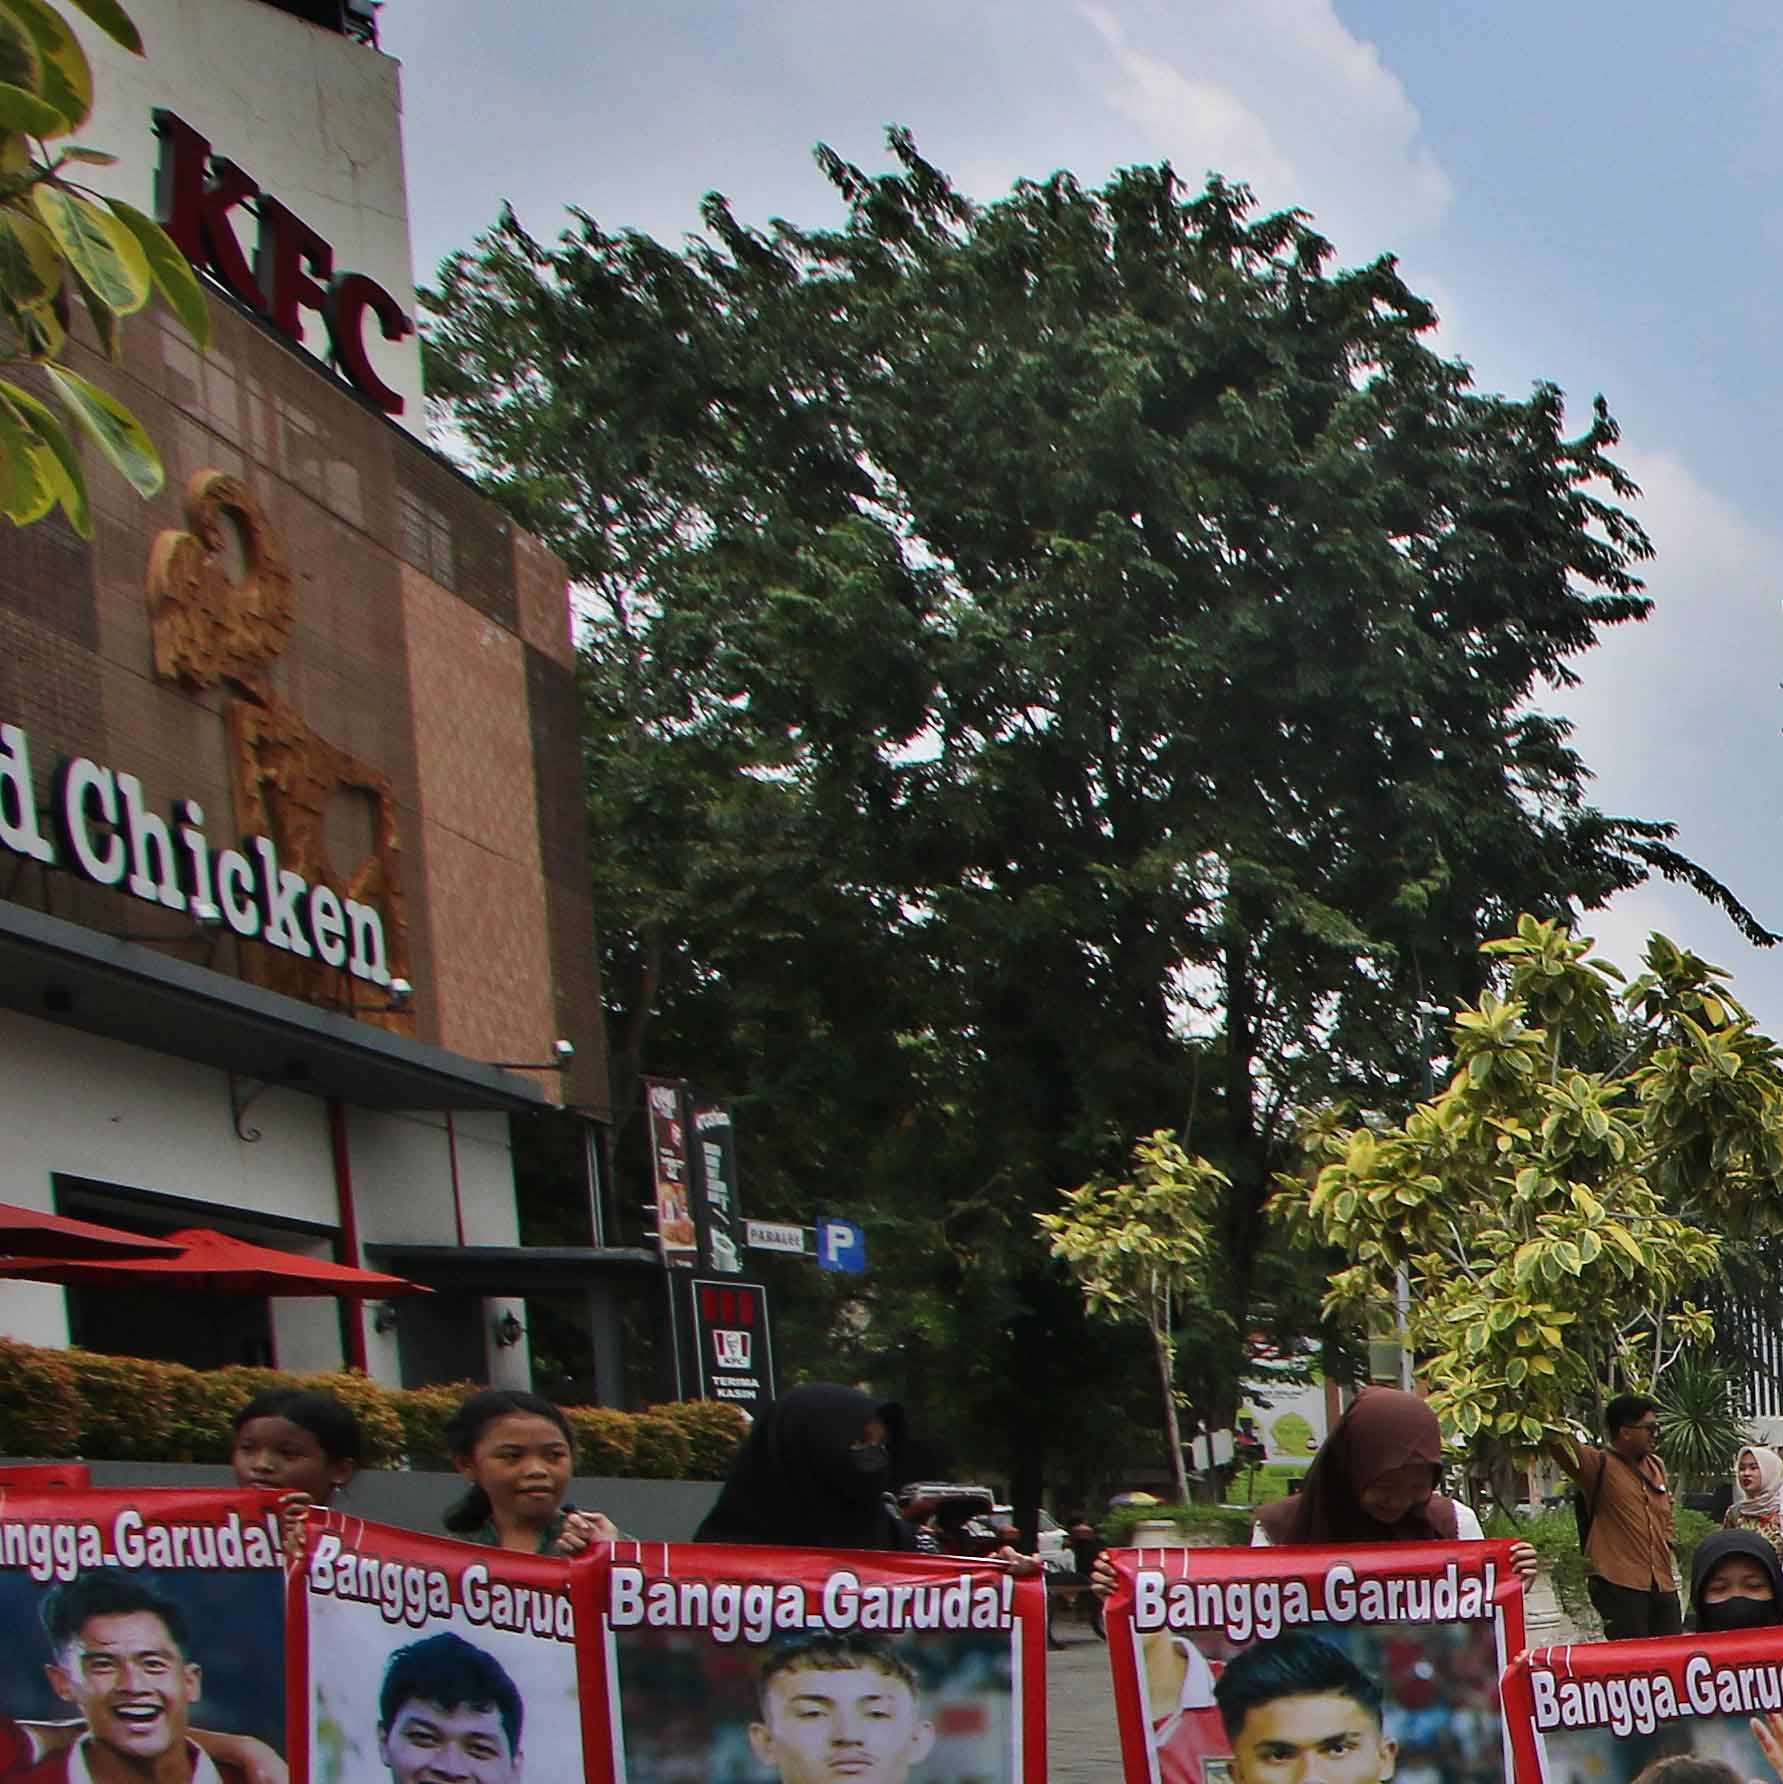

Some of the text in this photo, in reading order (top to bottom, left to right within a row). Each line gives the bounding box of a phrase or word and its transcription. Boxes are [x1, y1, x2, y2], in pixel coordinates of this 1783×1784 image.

[154, 109, 416, 414] KFC
[66, 756, 391, 985] Chicken
[827, 1224, 855, 1262] P
[711, 1375, 761, 1388] TERIMA
[0, 1509, 285, 1582] ngga Garuda!
[309, 1533, 576, 1639] Bangga Garud
[609, 1565, 1014, 1643] Bangga Garuda!
[1135, 1562, 1496, 1641] Bangga Garuda!
[1530, 1669, 1681, 1737] Bangga
